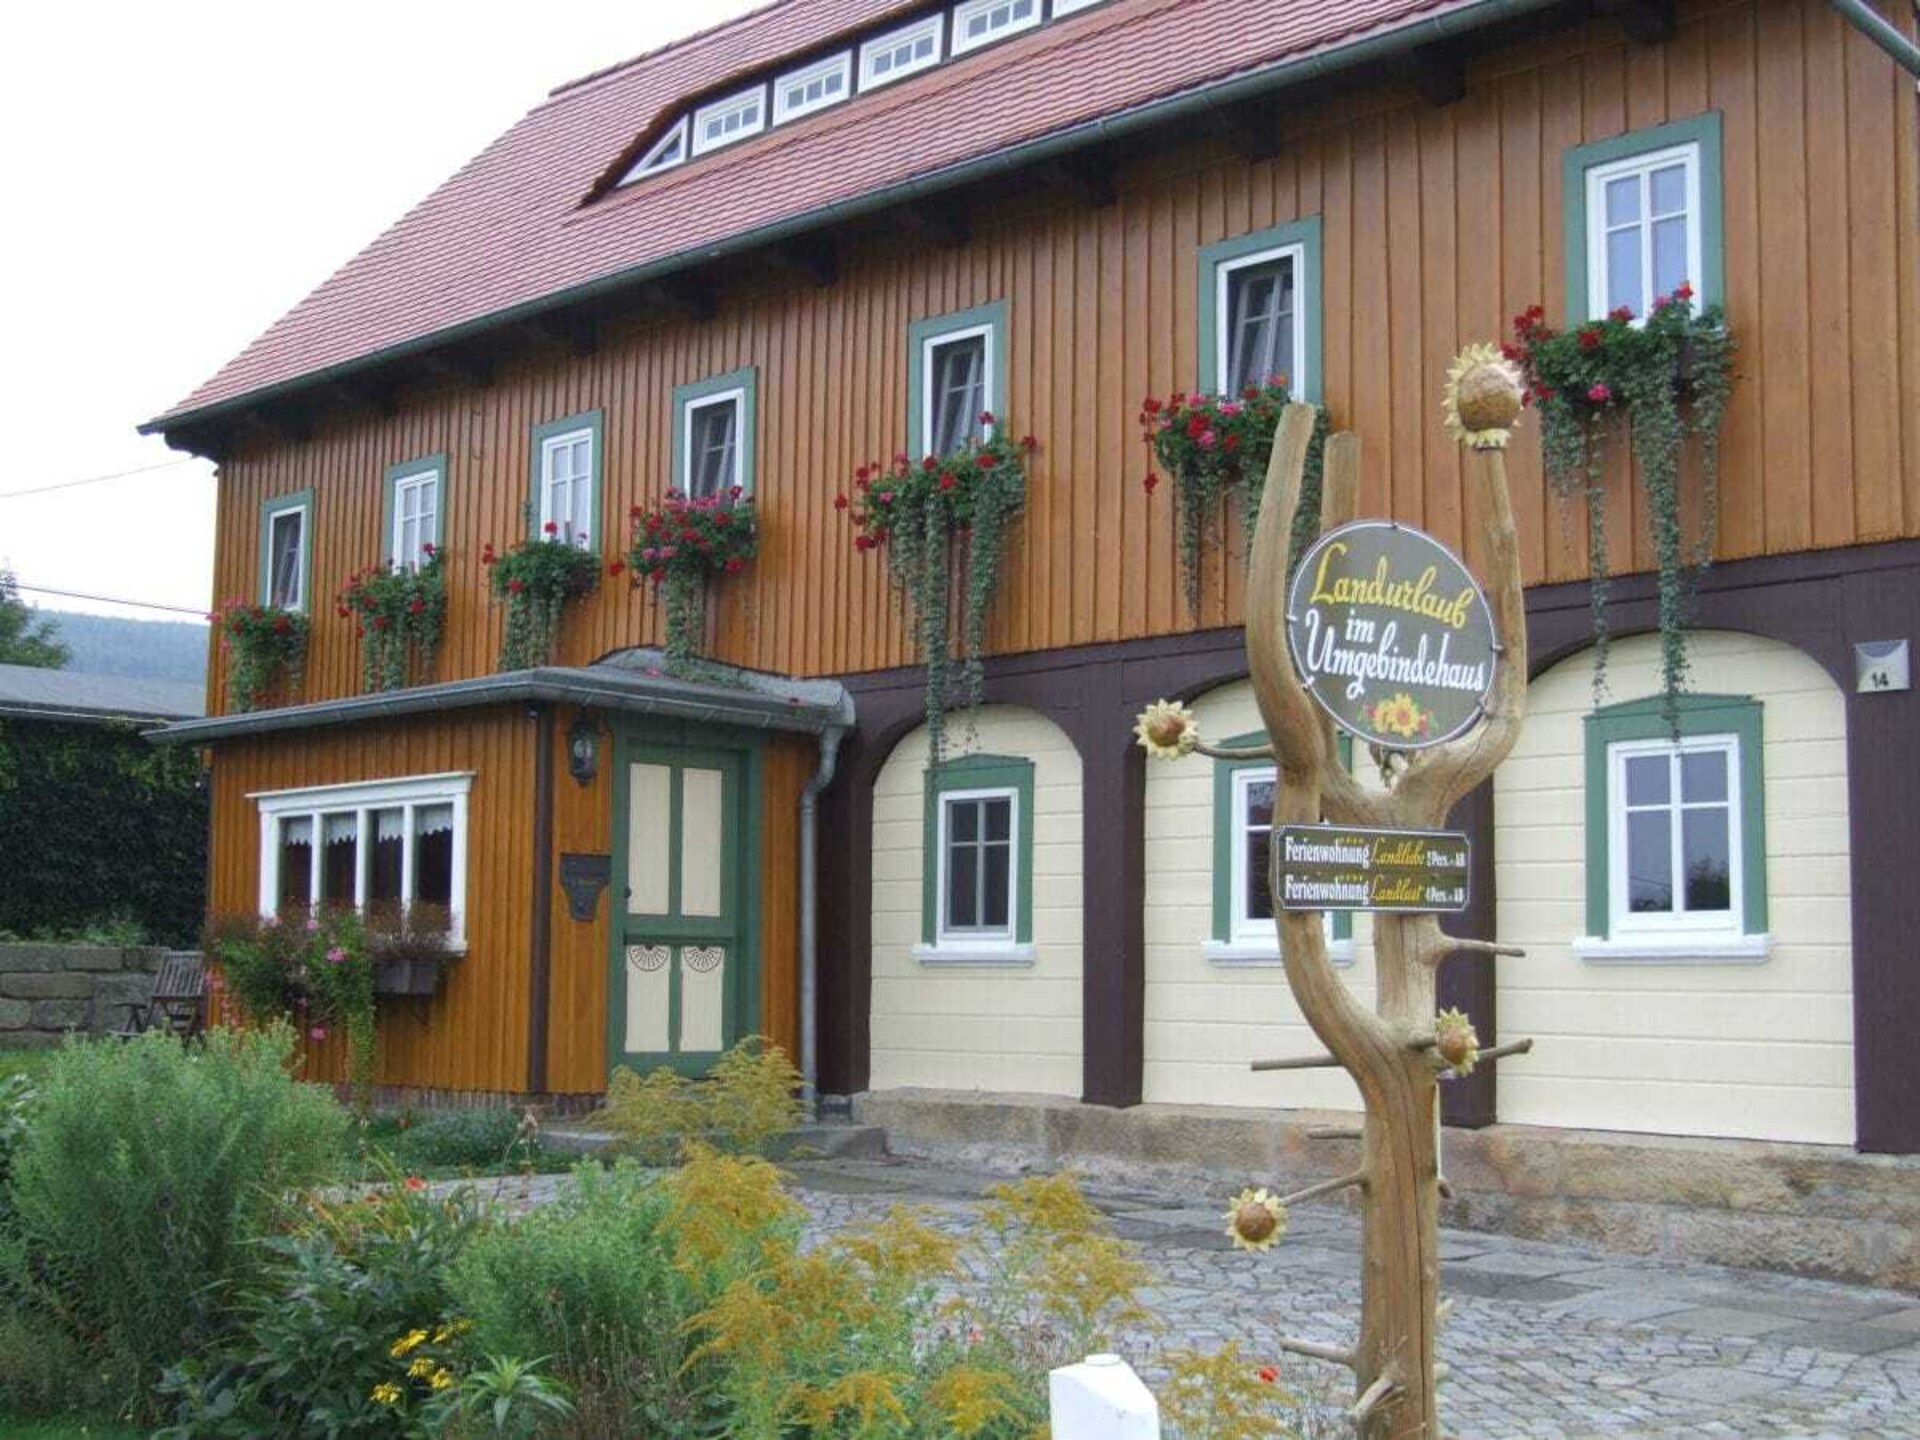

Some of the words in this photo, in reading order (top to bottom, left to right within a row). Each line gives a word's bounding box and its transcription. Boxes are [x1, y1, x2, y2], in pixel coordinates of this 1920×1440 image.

[1310, 542, 1474, 629] Landurlaub
[1345, 608, 1376, 644] im
[1305, 608, 1485, 700] Umgebindehaus
[1871, 671, 1890, 689] 14
[1285, 836, 1370, 869] Ferienwohnung
[1285, 874, 1370, 905] Ferienwohnung
